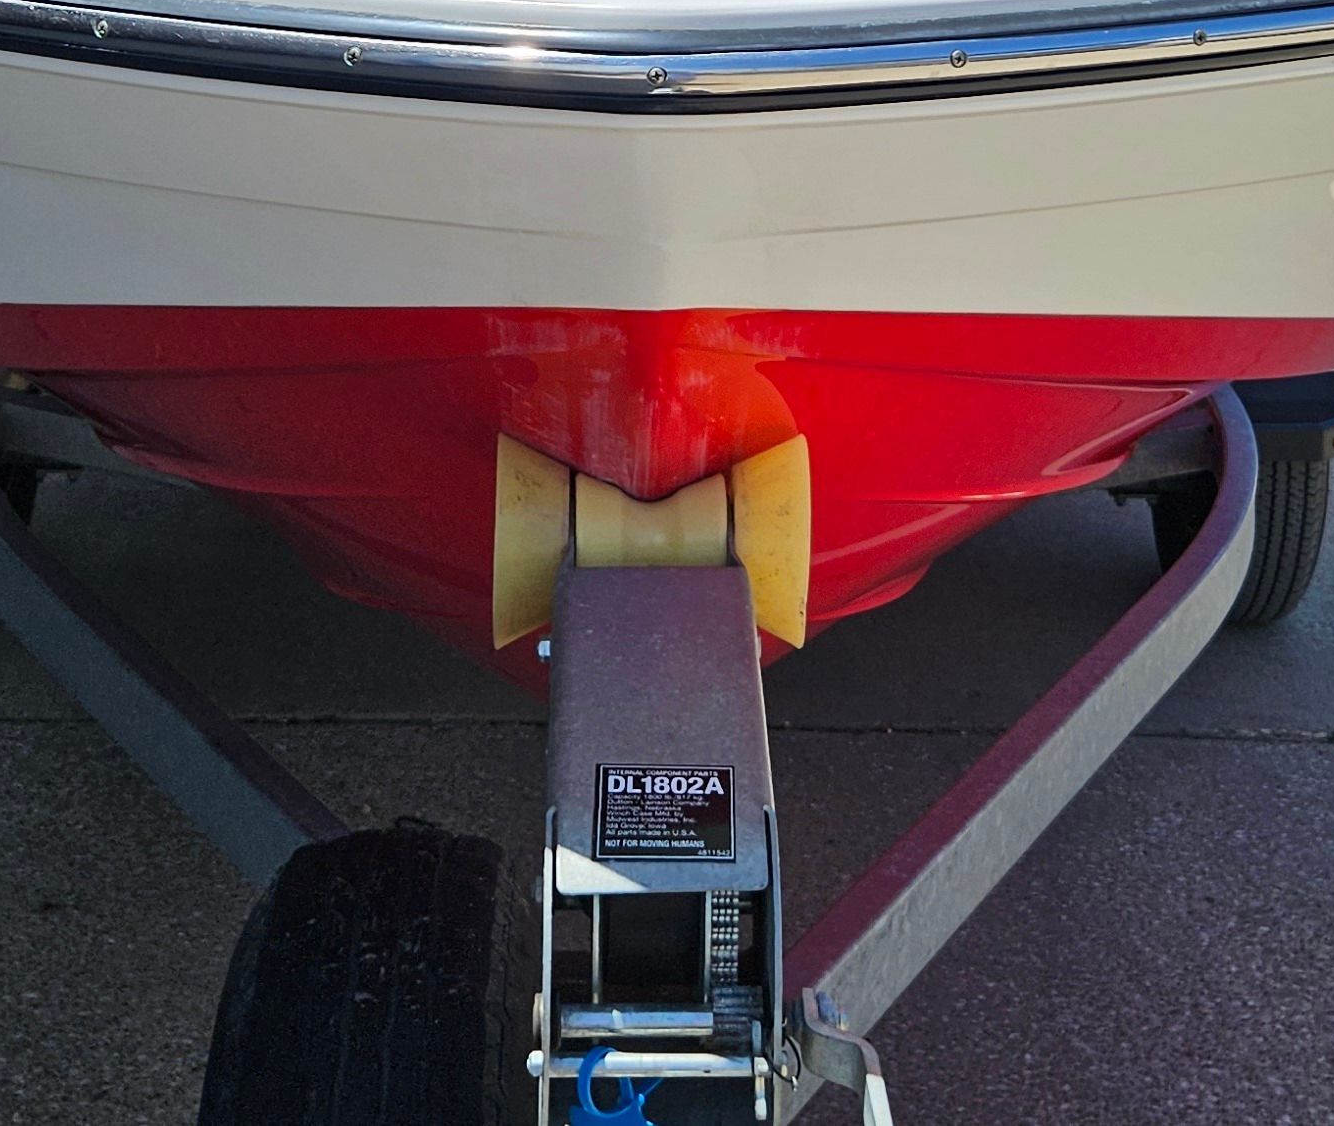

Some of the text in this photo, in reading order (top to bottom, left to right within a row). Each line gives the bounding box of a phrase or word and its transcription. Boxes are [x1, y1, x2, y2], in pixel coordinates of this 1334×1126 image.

[607, 775, 725, 795] DL1802A
[604, 839, 705, 848] NOT FOR MOVING HUMANS
